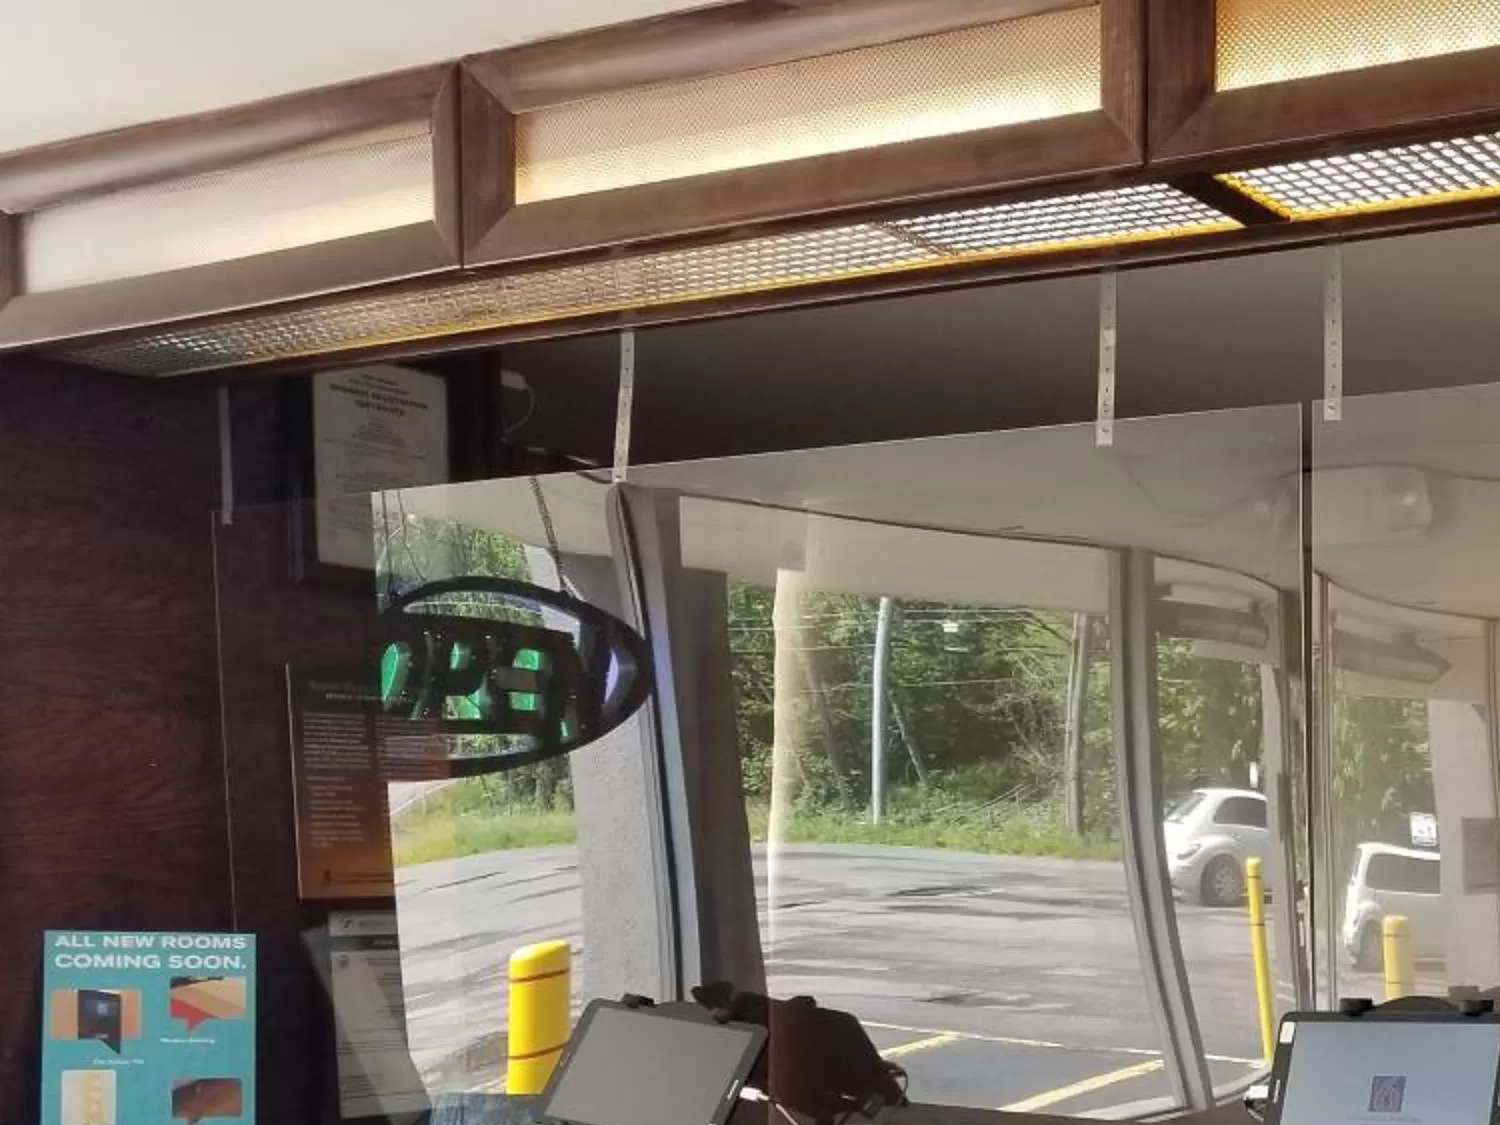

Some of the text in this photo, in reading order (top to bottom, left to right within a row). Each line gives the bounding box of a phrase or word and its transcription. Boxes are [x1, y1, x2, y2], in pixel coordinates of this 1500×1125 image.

[54, 935, 248, 950] ALL NEW ROOMS
[54, 953, 248, 970] COMING SOON.
